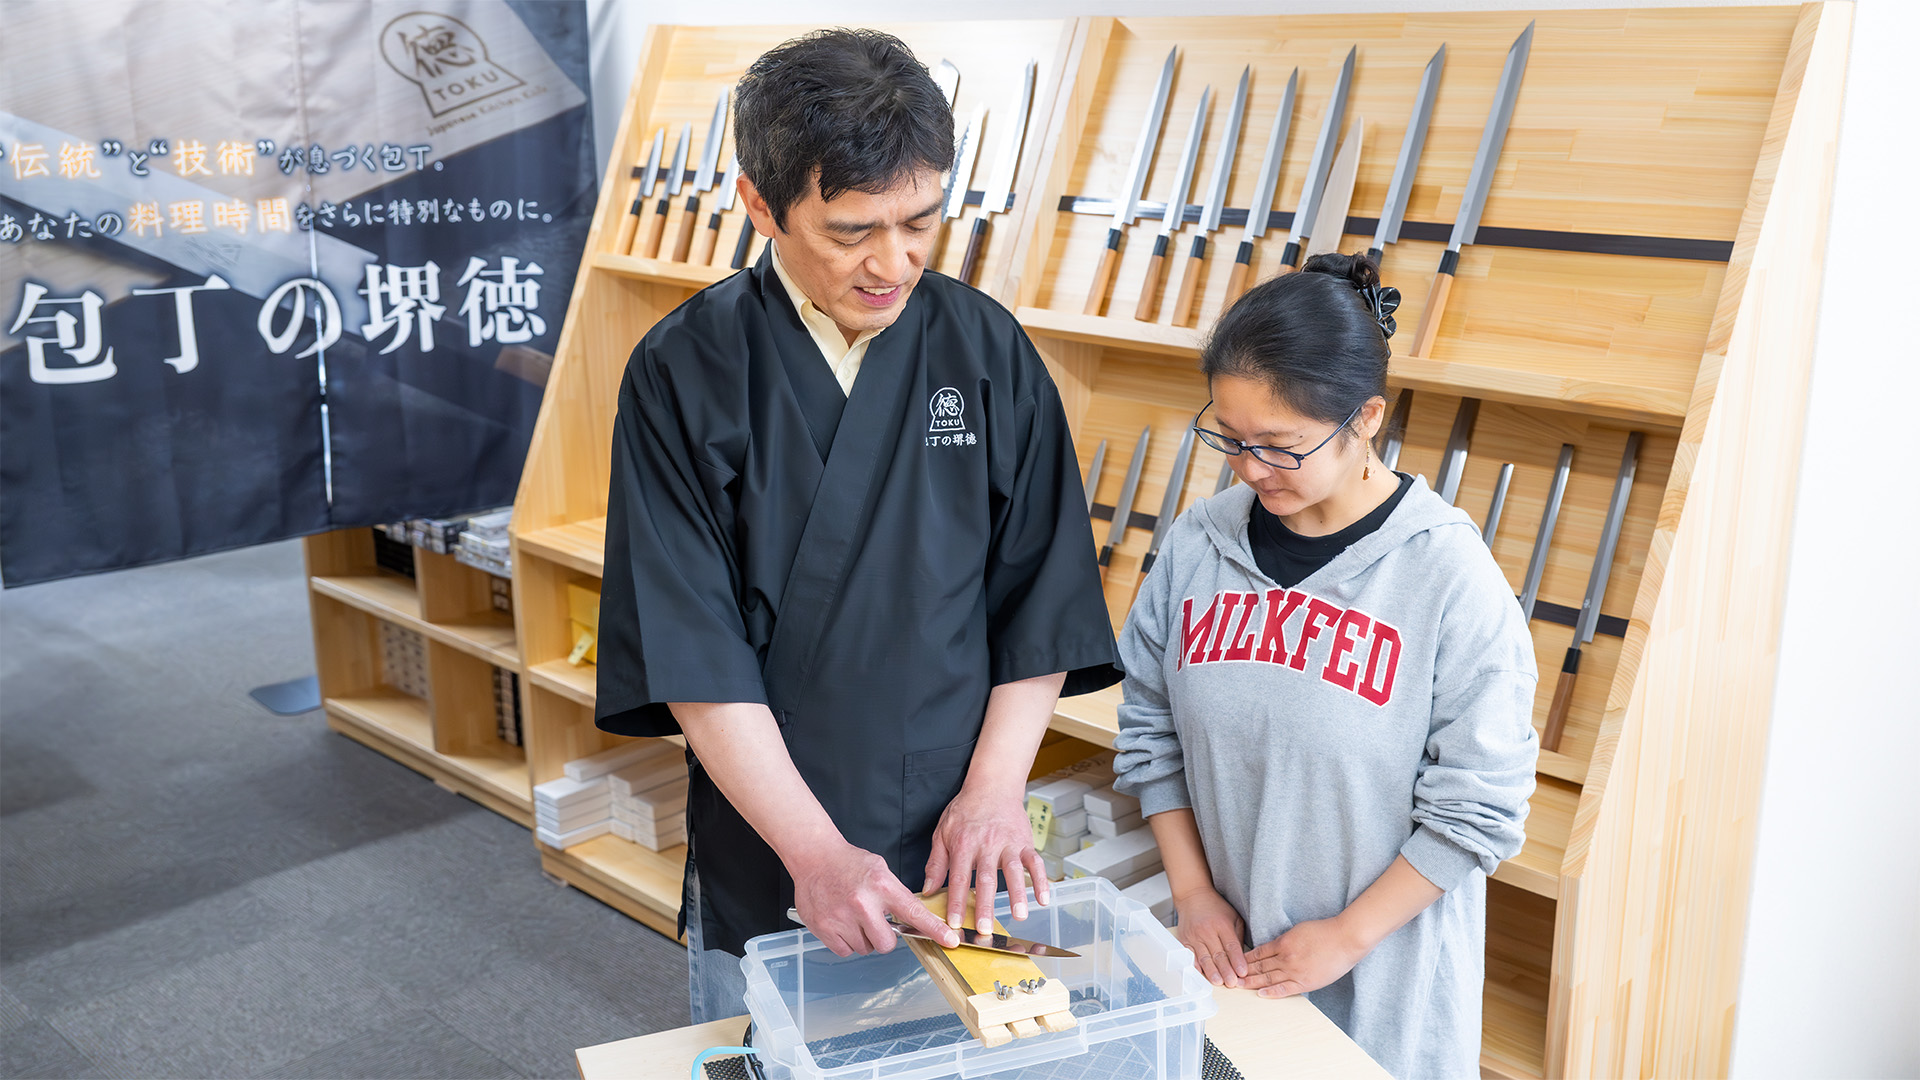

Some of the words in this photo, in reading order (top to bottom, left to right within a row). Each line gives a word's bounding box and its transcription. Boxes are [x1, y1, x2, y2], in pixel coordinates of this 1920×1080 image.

[433, 70, 499, 101] TOKU
[0, 139, 445, 180] 伝統”と“技術”が息づく包丁。
[0, 197, 553, 242] あなたの料理時間をさらに特別なものに。
[9, 256, 547, 384] 包丁の堺徳
[925, 431, 977, 446] 丁の堺徳
[935, 419, 960, 427] TOKU
[1177, 587, 1404, 707] MILKFED
